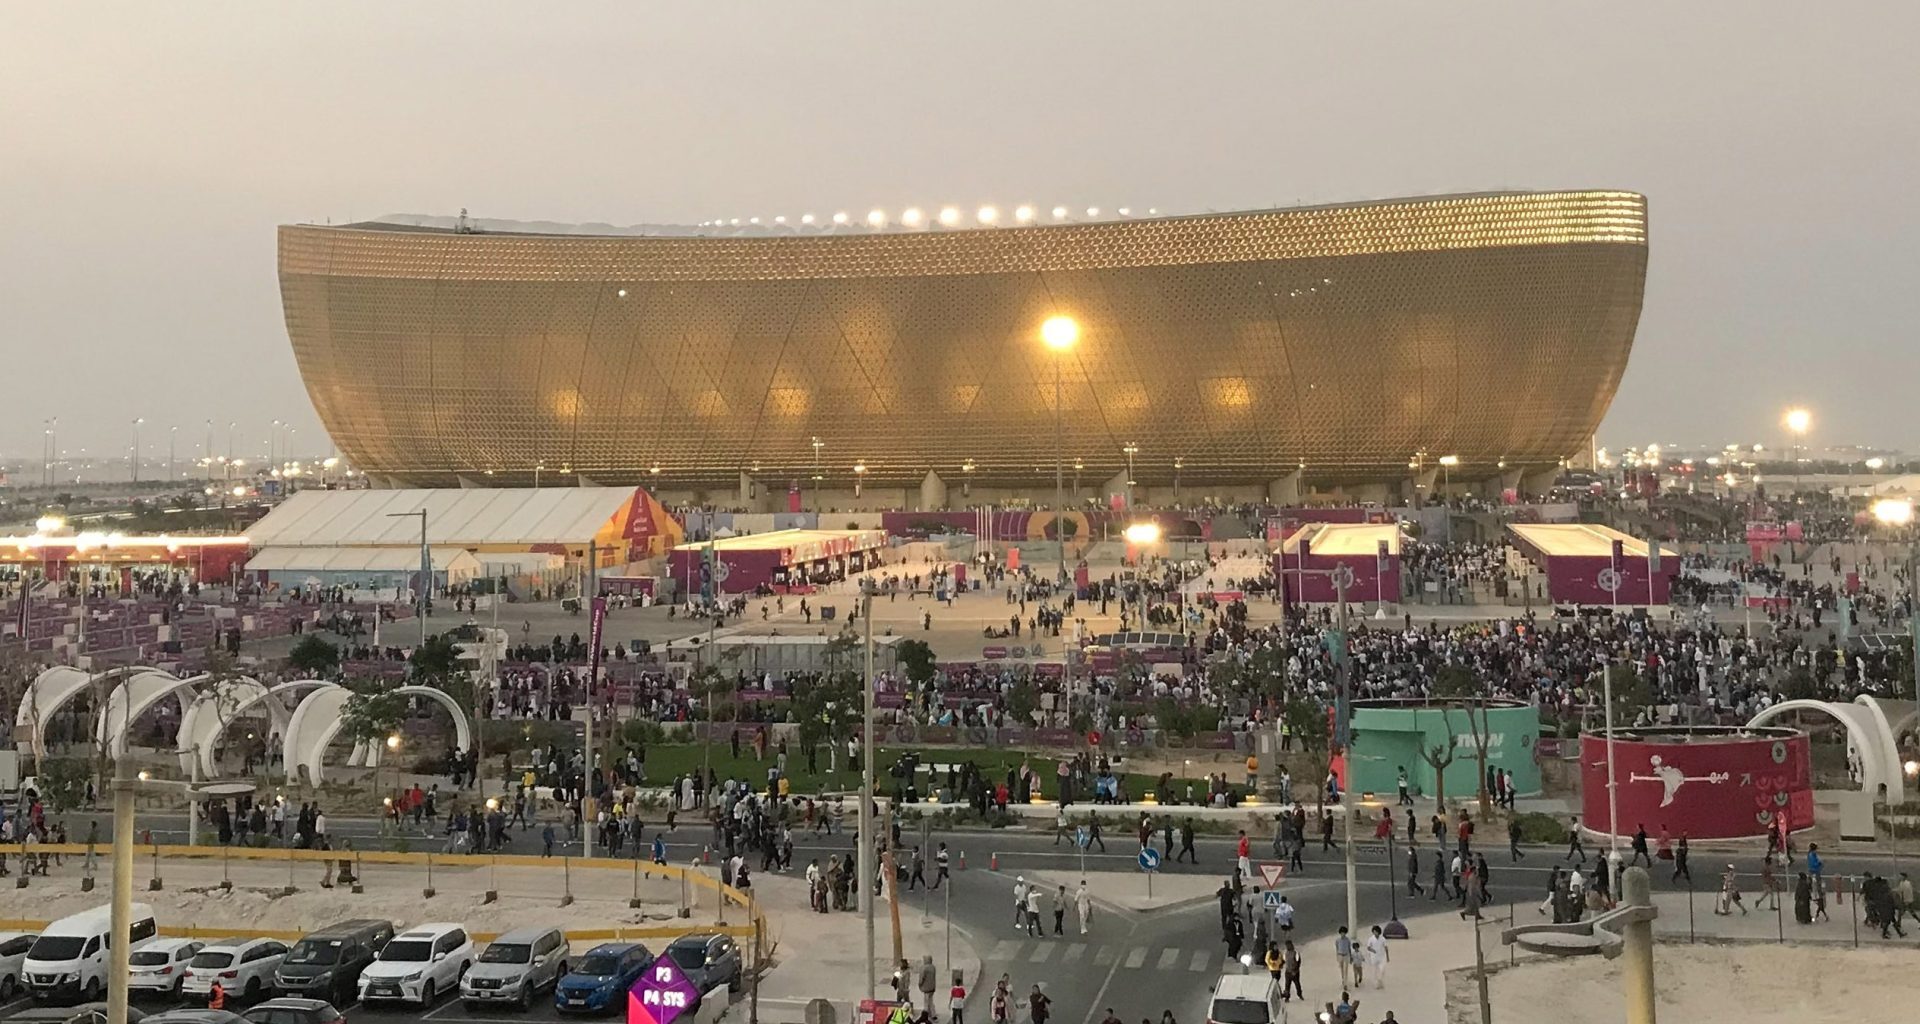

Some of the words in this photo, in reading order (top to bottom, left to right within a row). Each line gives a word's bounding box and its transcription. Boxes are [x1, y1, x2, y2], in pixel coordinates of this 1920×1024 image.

[656, 966, 671, 982] P3
[643, 989, 660, 1005] P4
[663, 991, 685, 1007] SYS
